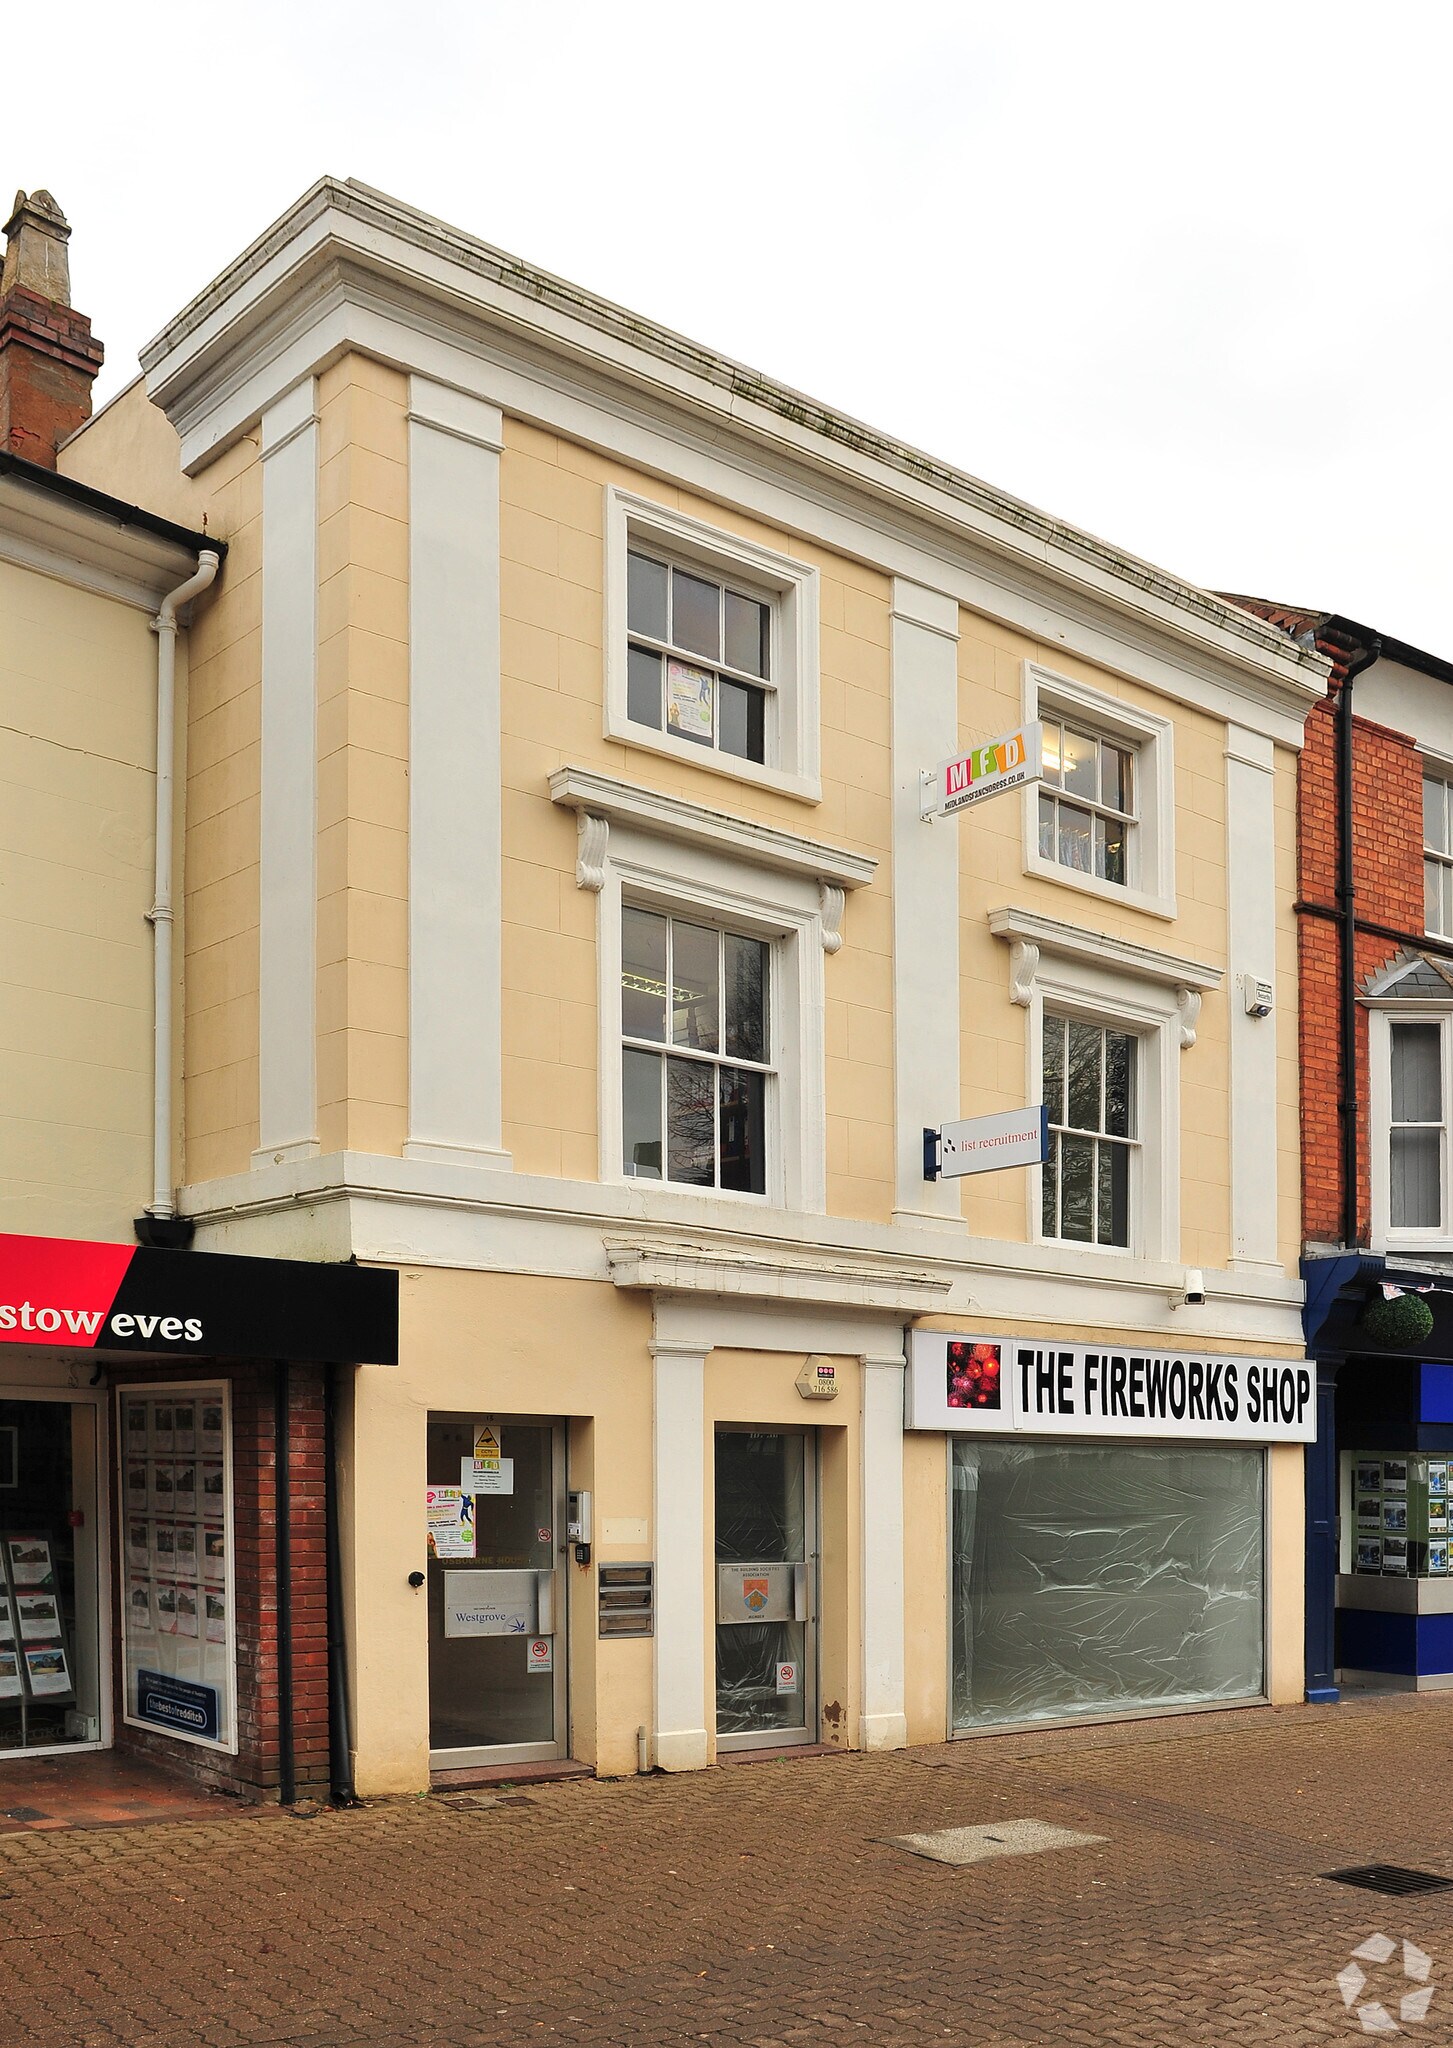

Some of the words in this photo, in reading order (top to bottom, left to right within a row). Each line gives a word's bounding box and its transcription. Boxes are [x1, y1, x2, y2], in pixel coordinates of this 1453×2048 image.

[960, 1140, 977, 1152] list
[979, 1129, 1038, 1149] recruitment
[0, 1301, 104, 1335] stow
[110, 1313, 204, 1342] eves
[813, 1385, 826, 1393] 716
[1017, 1349, 1075, 1415] THE
[1084, 1354, 1239, 1422] FIREWORKS
[1246, 1365, 1311, 1424] SHOP
[455, 1612, 506, 1624] Westgrove
